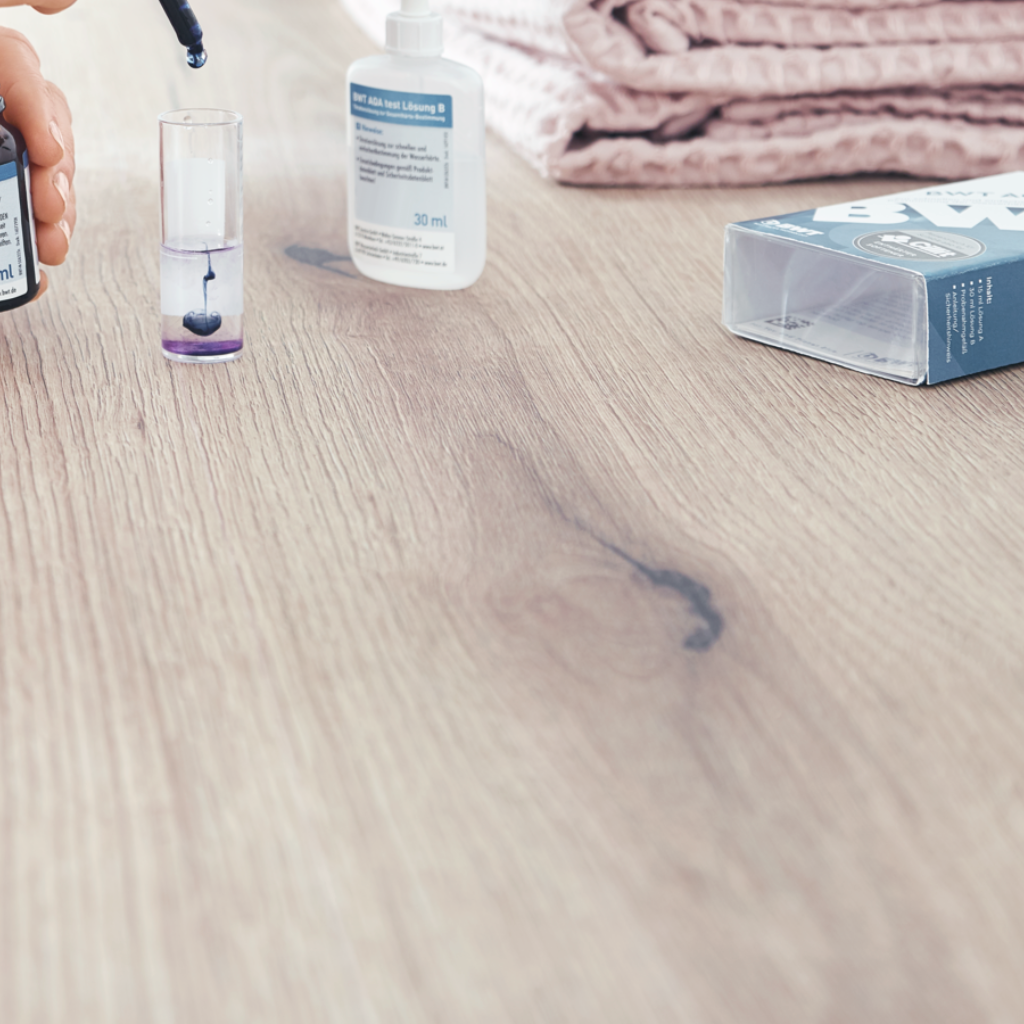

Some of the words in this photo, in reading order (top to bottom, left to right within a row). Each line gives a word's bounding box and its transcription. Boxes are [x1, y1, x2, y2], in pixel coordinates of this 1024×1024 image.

[384, 99, 400, 110] test
[402, 101, 436, 115] Lösung
[438, 103, 445, 113] B
[926, 190, 994, 198] BWT
[0, 212, 8, 220] DEN
[414, 212, 429, 227] 30
[431, 215, 448, 228] ml
[969, 287, 975, 298] 30
[977, 285, 984, 294] 15
[969, 298, 976, 309] ml
[978, 295, 984, 305] ml
